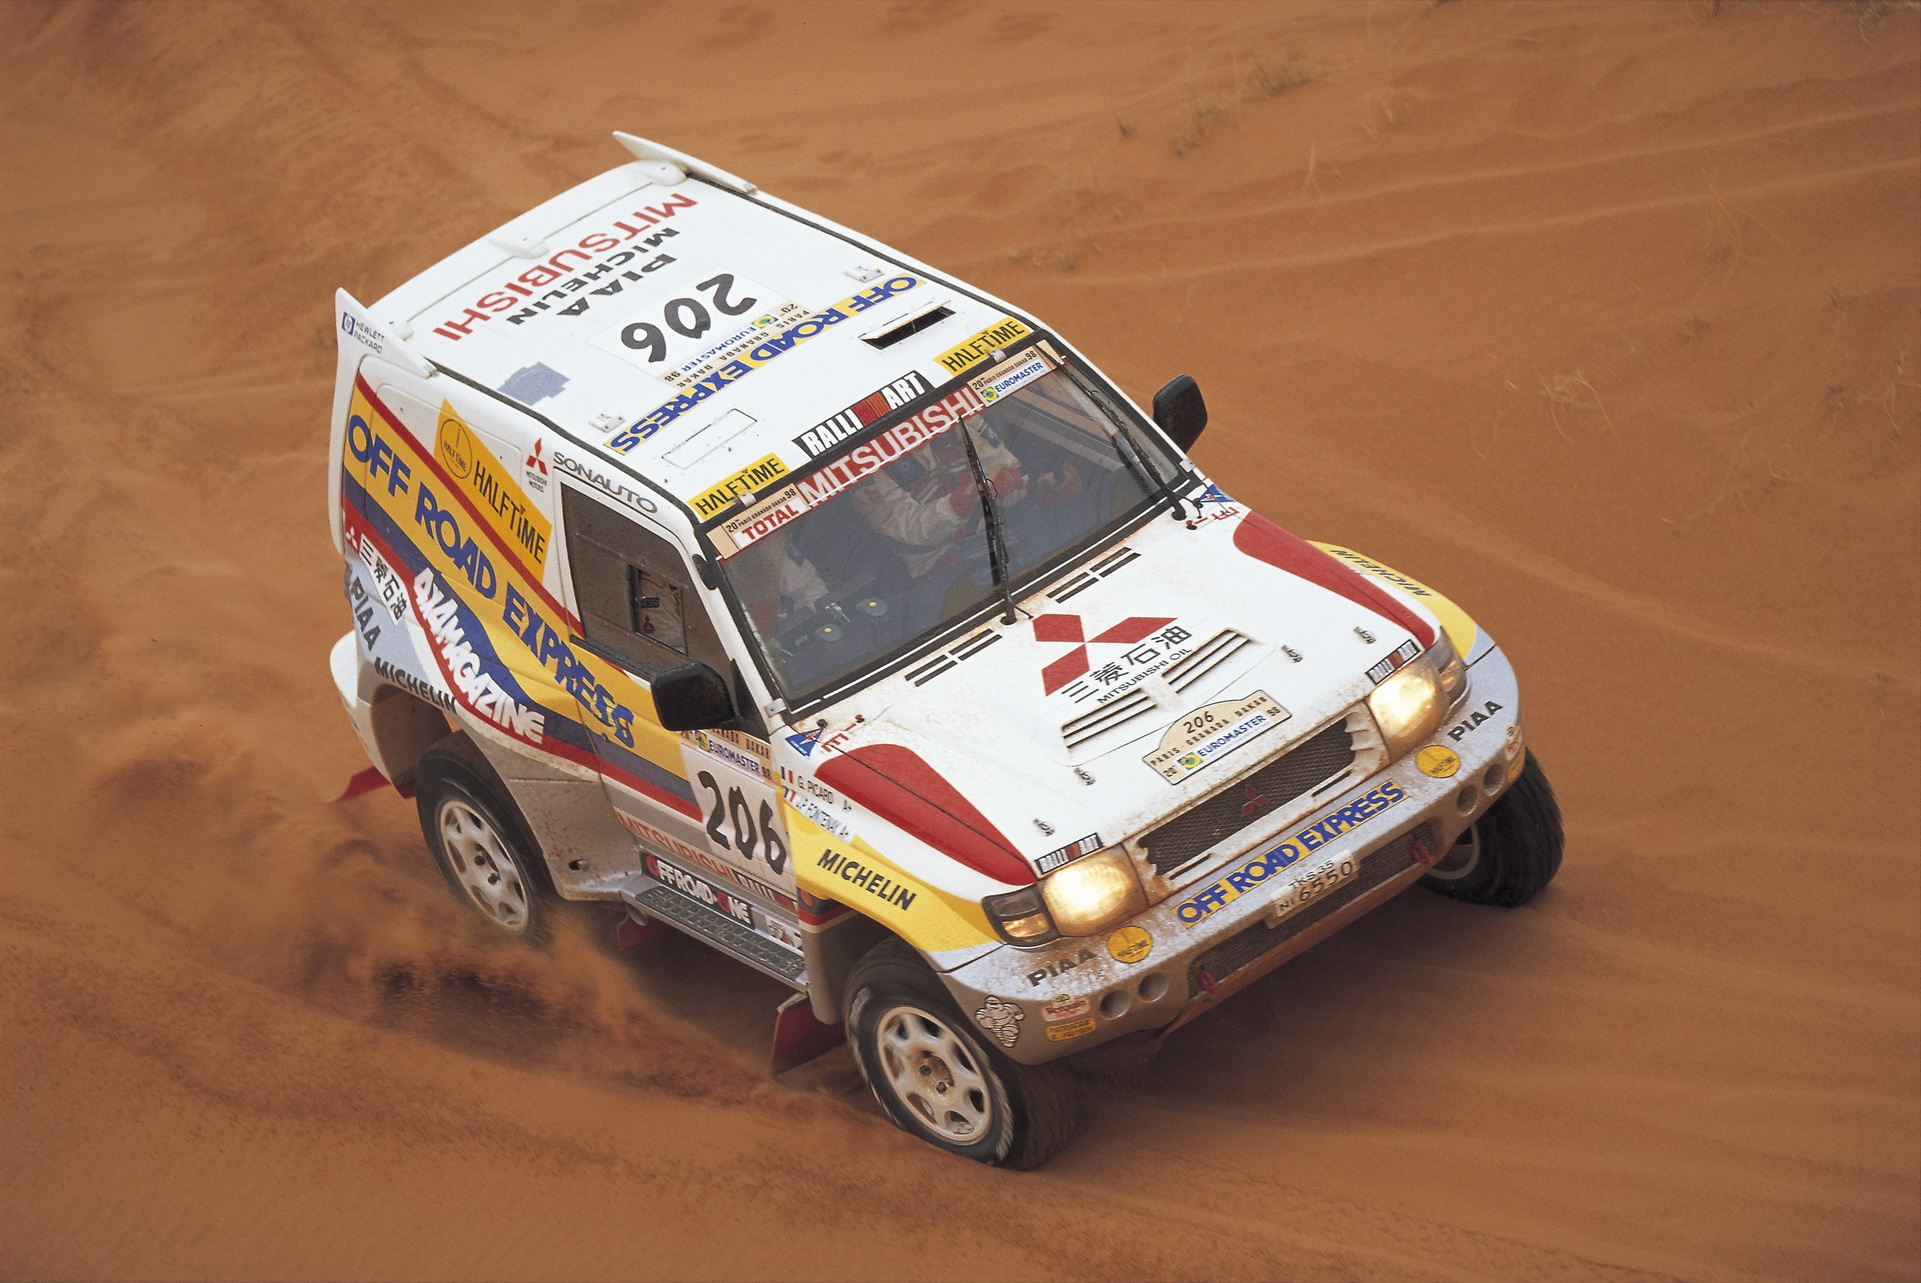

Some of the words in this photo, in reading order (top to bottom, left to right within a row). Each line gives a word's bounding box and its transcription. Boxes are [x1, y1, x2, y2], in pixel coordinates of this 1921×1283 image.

[432, 193, 698, 341] MITSUBISHI
[506, 227, 680, 325] MICHELIN
[556, 253, 677, 316] PIAA
[621, 274, 757, 362] 206
[846, 275, 918, 313] OFF
[353, 330, 383, 354] PACKARD
[355, 320, 385, 342] HEWLETT
[749, 309, 850, 363] ROAD
[776, 310, 810, 329] PARIS
[681, 326, 757, 372] EUROMASTER
[719, 332, 770, 361] GRANADA
[1025, 350, 1037, 361] 98
[676, 364, 714, 388] DAKAR
[994, 361, 1044, 393] EUROMASTER
[610, 359, 755, 454] EXPRESS
[797, 387, 983, 508] MITSUBISHI
[554, 451, 658, 514] SONAUTO
[785, 488, 797, 500] 98
[741, 504, 799, 541] TOTAL
[348, 414, 411, 498] OFF
[414, 480, 497, 600] ROAD
[502, 581, 635, 749] EXPRESS
[361, 538, 408, 620] 三菱石油
[1330, 549, 1431, 597] MICHELIN
[351, 577, 381, 652] PIAA
[374, 656, 458, 715] MICHELIN
[1061, 625, 1193, 704] 三菱石油
[1097, 659, 1170, 705] MITSUBISHI
[1170, 647, 1193, 662] OIL
[1182, 710, 1215, 734] 206
[1196, 714, 1266, 758] EUROMASTER
[1447, 700, 1503, 742] PIAA
[709, 740, 760, 772] EUROMASTER
[697, 770, 787, 875] 206
[1176, 884, 1229, 924] OFF
[1229, 843, 1300, 895] ROAD
[1301, 782, 1405, 850] EXPRESS
[817, 849, 917, 911] MICHELIN
[1299, 861, 1353, 901] 6550
[1027, 949, 1097, 988] PIAA
